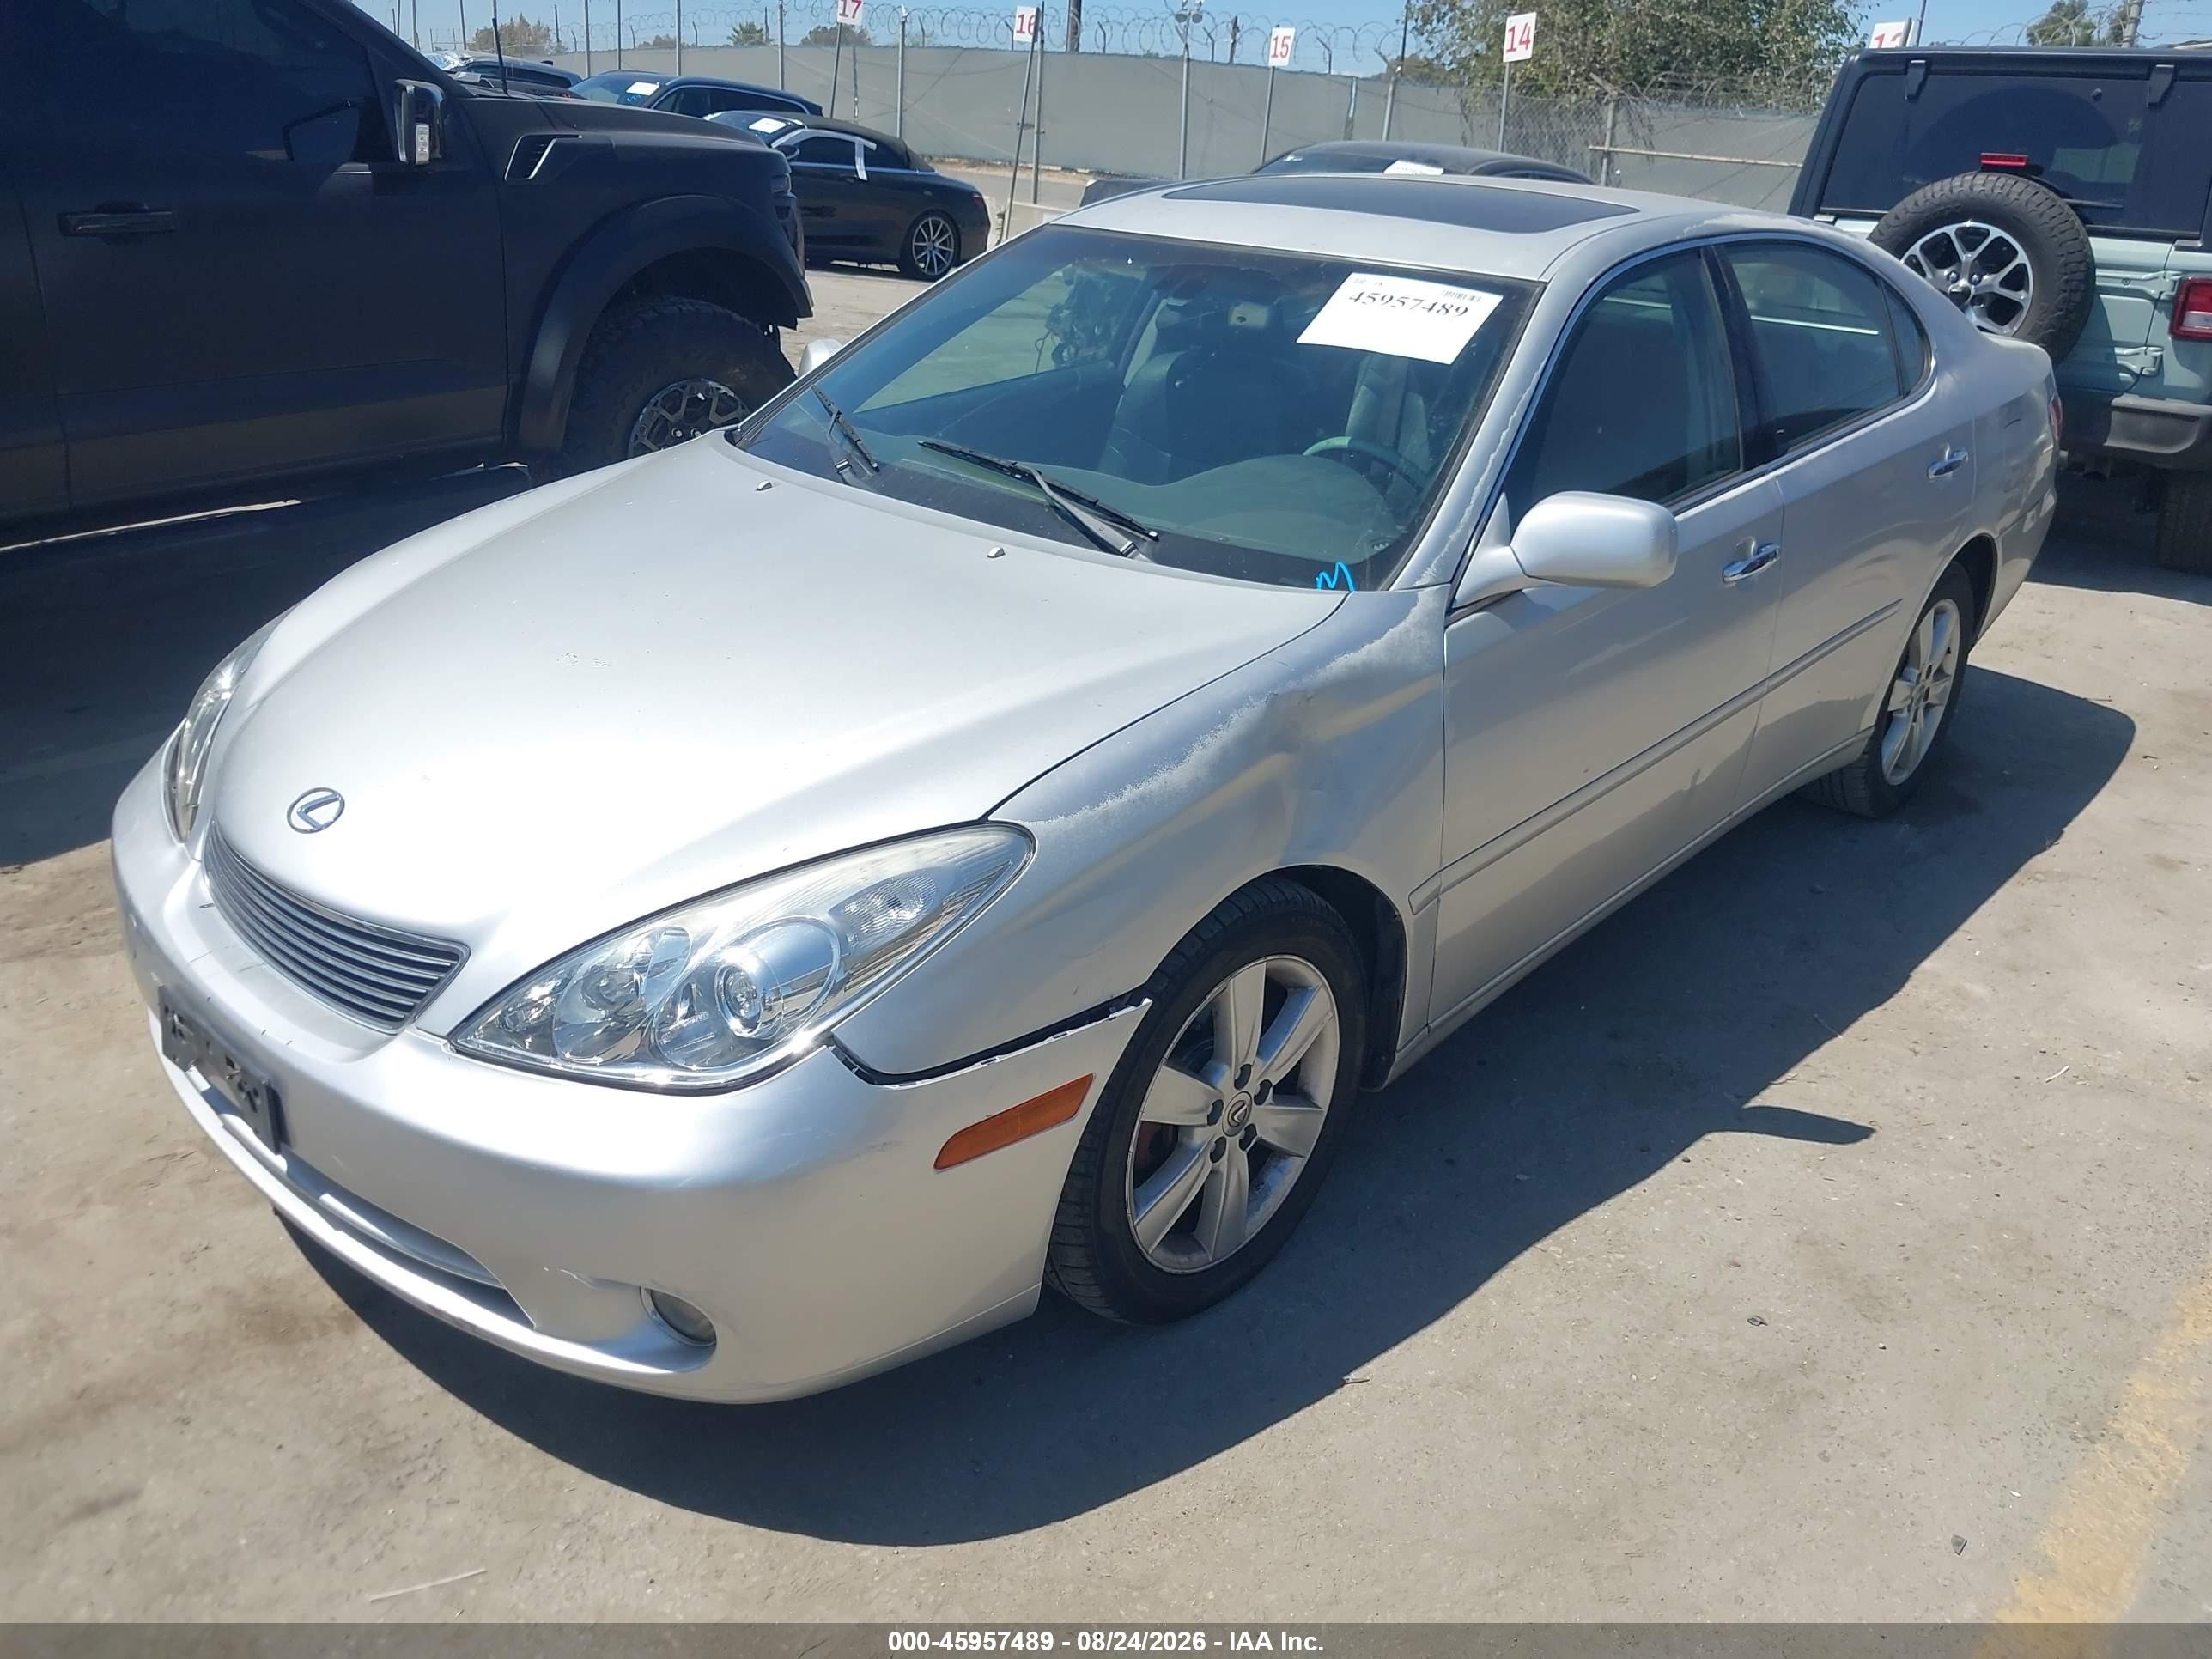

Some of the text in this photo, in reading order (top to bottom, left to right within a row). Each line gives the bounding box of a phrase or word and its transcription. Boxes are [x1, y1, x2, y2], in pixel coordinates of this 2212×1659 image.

[839, 0, 862, 18] 17
[1271, 35, 1291, 58] 15
[1506, 22, 1531, 52] 14
[1348, 291, 1469, 317] 45957489
